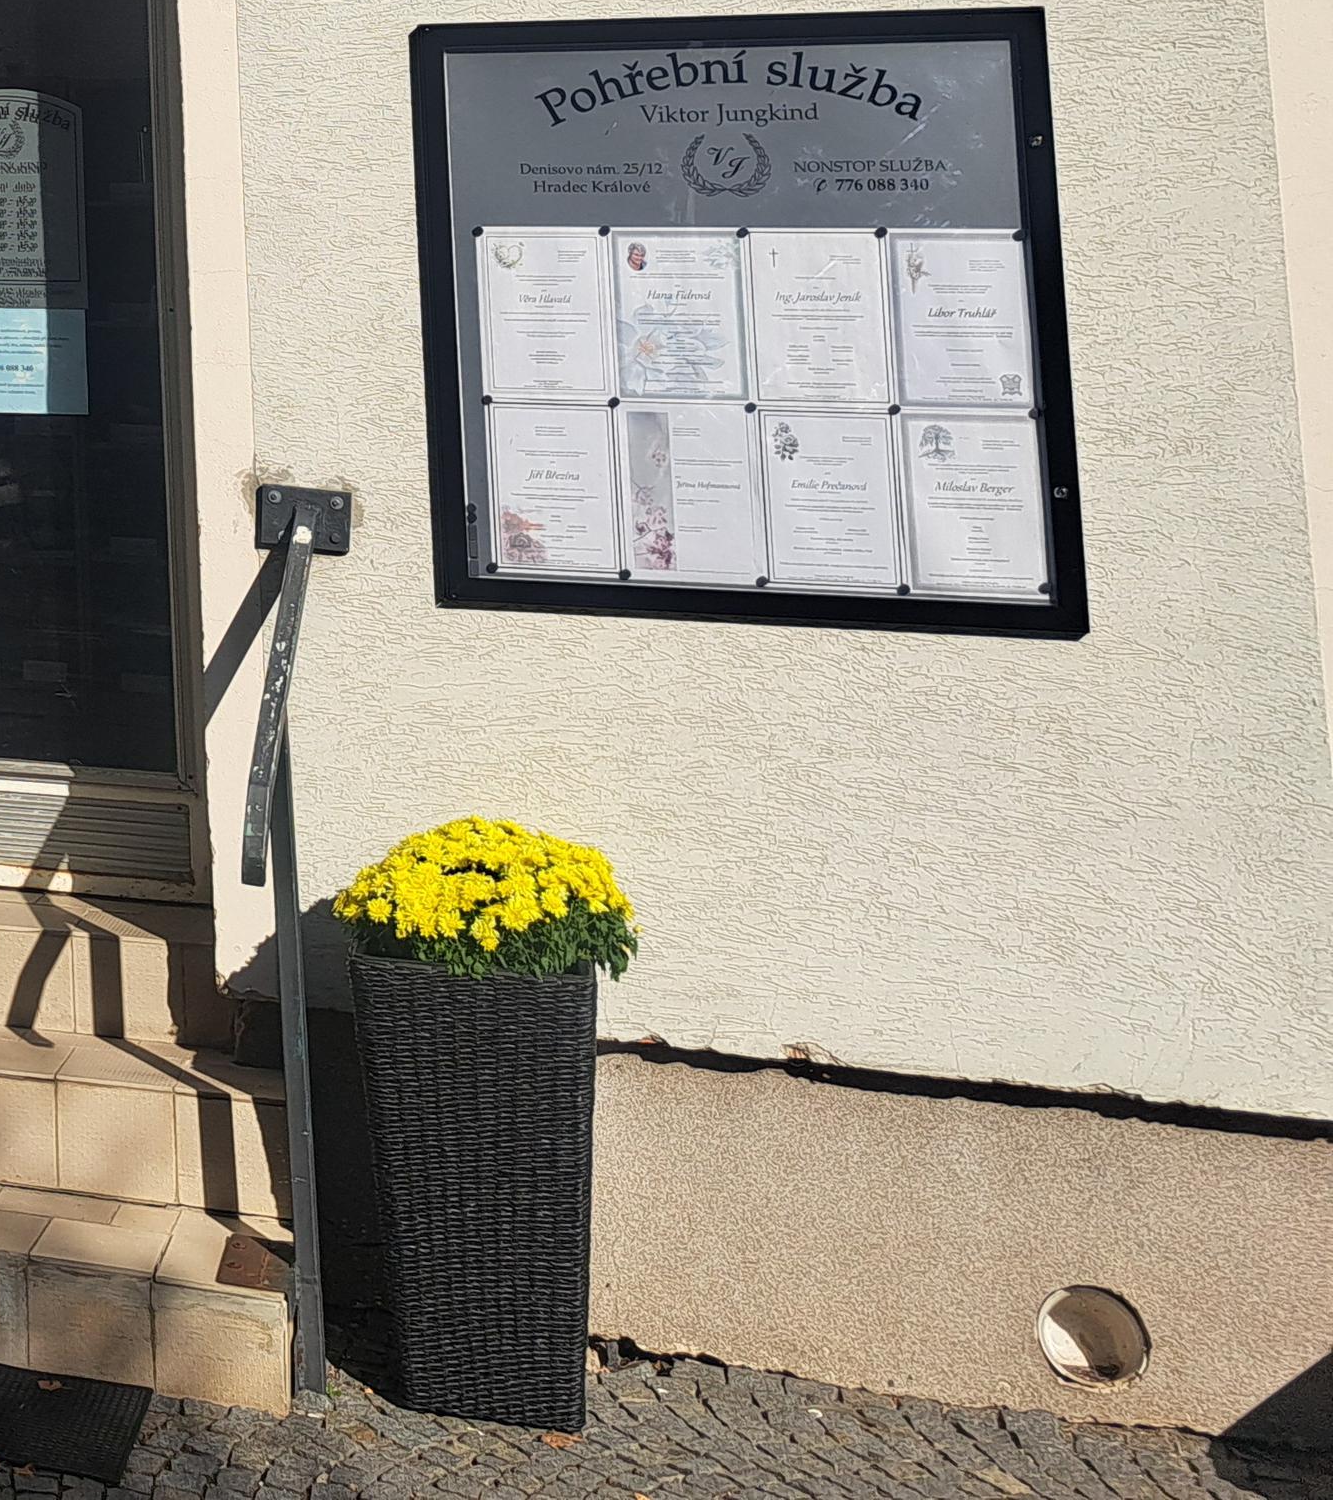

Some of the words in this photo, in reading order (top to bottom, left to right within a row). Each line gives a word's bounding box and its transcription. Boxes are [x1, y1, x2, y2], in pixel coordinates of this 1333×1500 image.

[534, 49, 749, 128] Pohřební
[765, 51, 924, 121] služba
[639, 102, 710, 125] Viktor
[716, 102, 820, 128] Jungkind
[520, 162, 585, 176] Denisovo
[586, 162, 621, 176] nám.
[622, 161, 663, 177] 25/12
[793, 159, 878, 174] NONSTOP
[879, 156, 949, 173] SLUŽBA
[532, 180, 589, 194] Hradec
[591, 180, 651, 194] Králové
[834, 178, 863, 192] 776
[866, 178, 897, 192] 088
[899, 177, 930, 191] 340
[646, 290, 673, 300] Hana
[793, 291, 834, 303] Jaroslav
[928, 307, 956, 318] Libor
[790, 478, 821, 490] Emilie
[934, 480, 978, 493] Miloslav
[979, 481, 1016, 496] Berger
